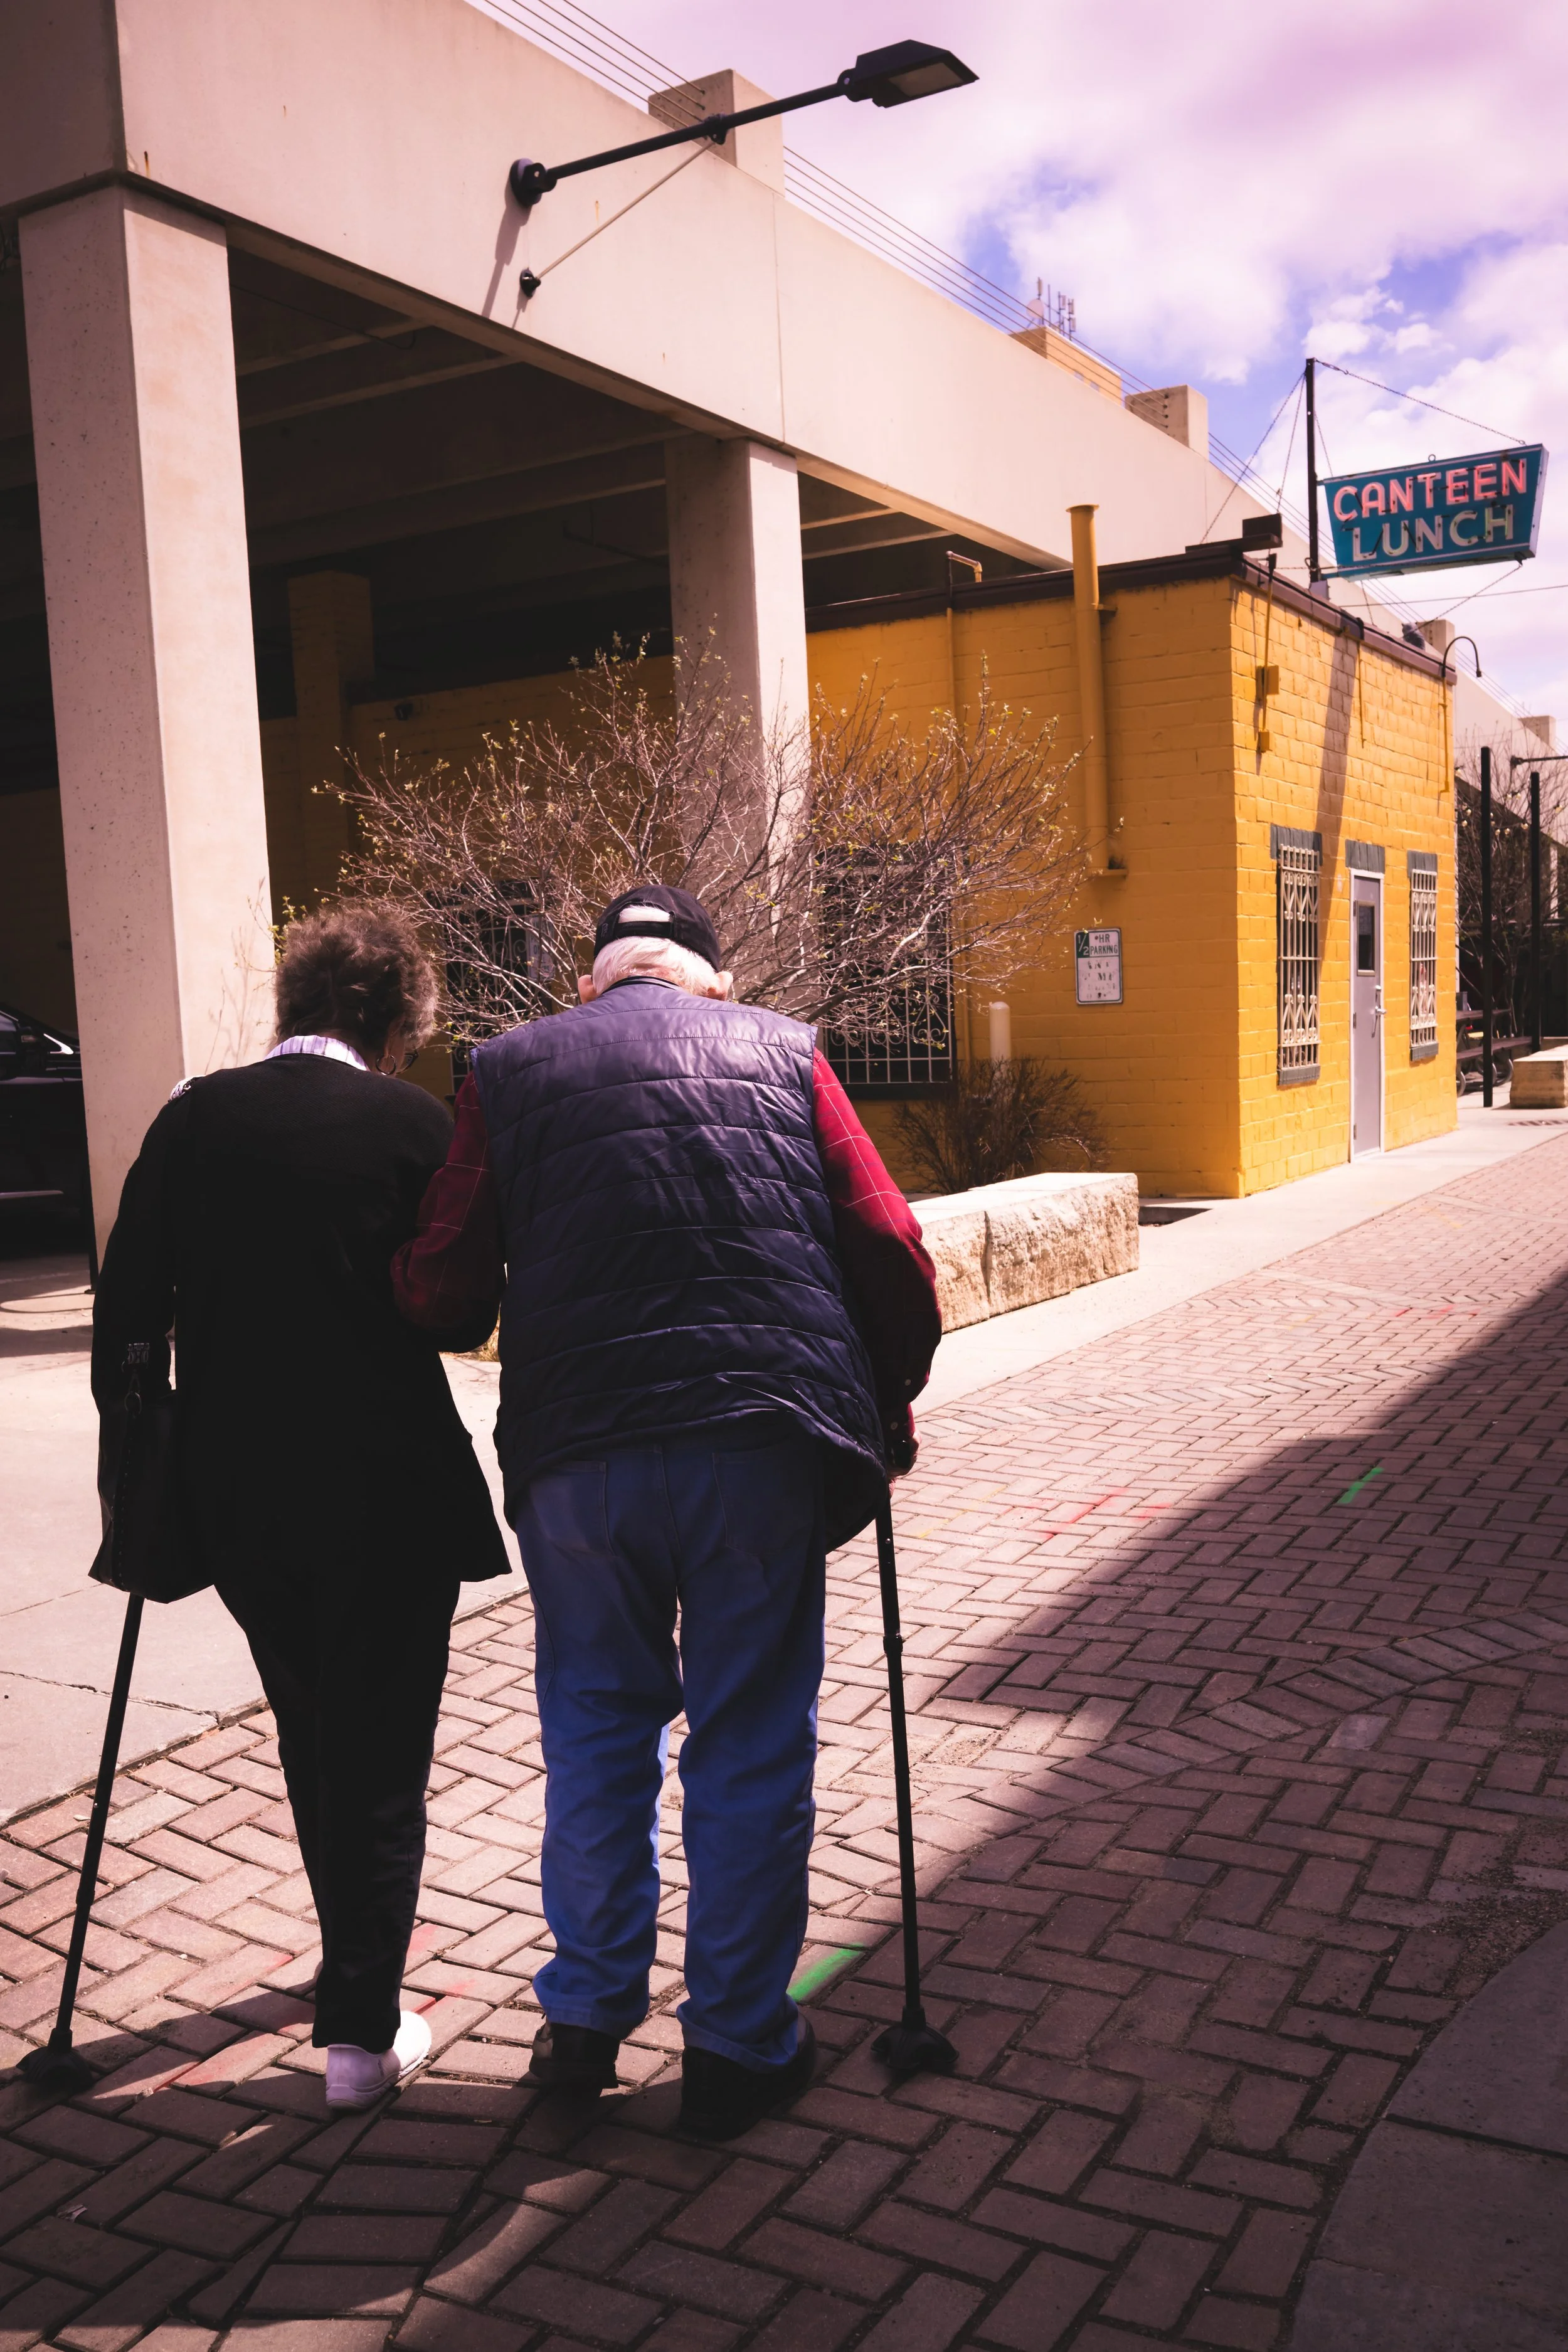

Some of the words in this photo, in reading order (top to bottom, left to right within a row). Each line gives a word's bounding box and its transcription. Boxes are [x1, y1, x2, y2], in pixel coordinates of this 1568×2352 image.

[1333, 458, 1527, 521] CANTEEN
[1353, 504, 1513, 562] LUNCH
[1090, 944, 1118, 955] PARKING
[1099, 933, 1110, 943] HR
